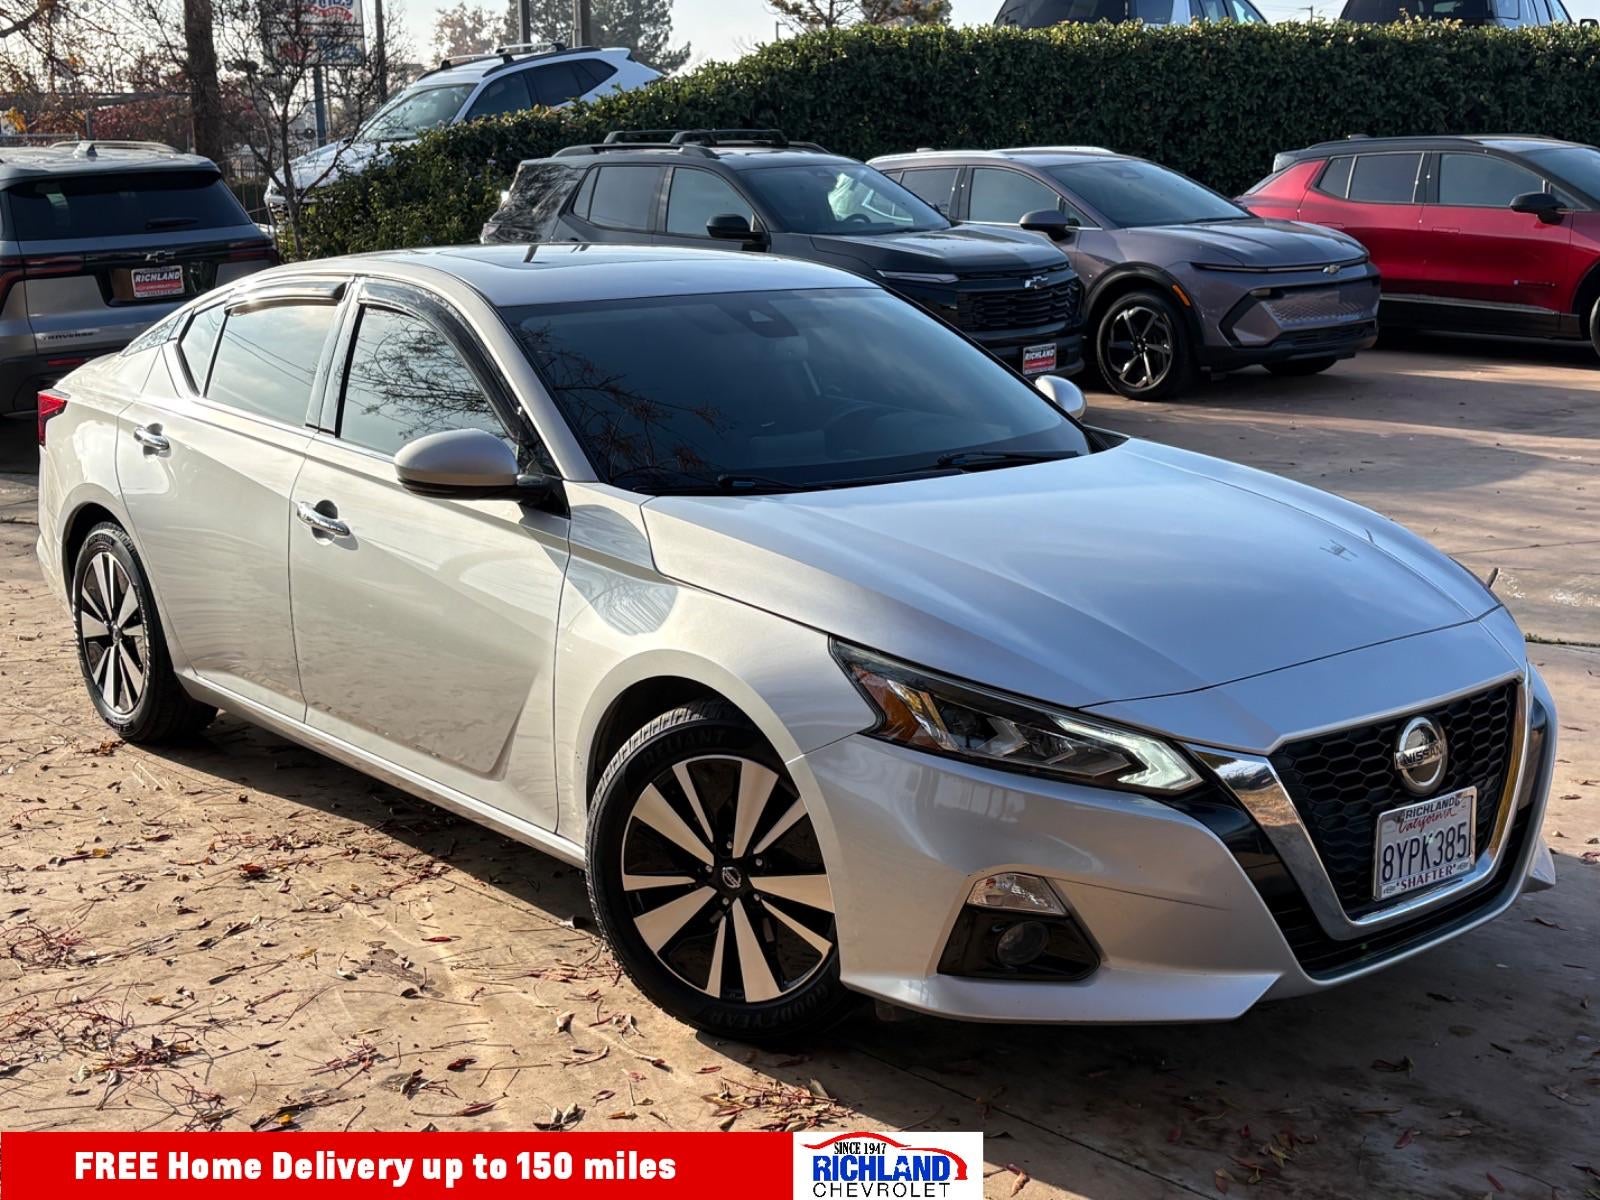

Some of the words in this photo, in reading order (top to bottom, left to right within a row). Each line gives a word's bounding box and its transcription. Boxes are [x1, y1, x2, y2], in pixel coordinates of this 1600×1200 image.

[135, 271, 180, 283] RICHLAND
[1402, 743, 1441, 764] NISSAN
[1405, 797, 1455, 819] RICHLAND
[1382, 821, 1467, 882] 8YPK385
[1401, 865, 1454, 889] SHAFTER
